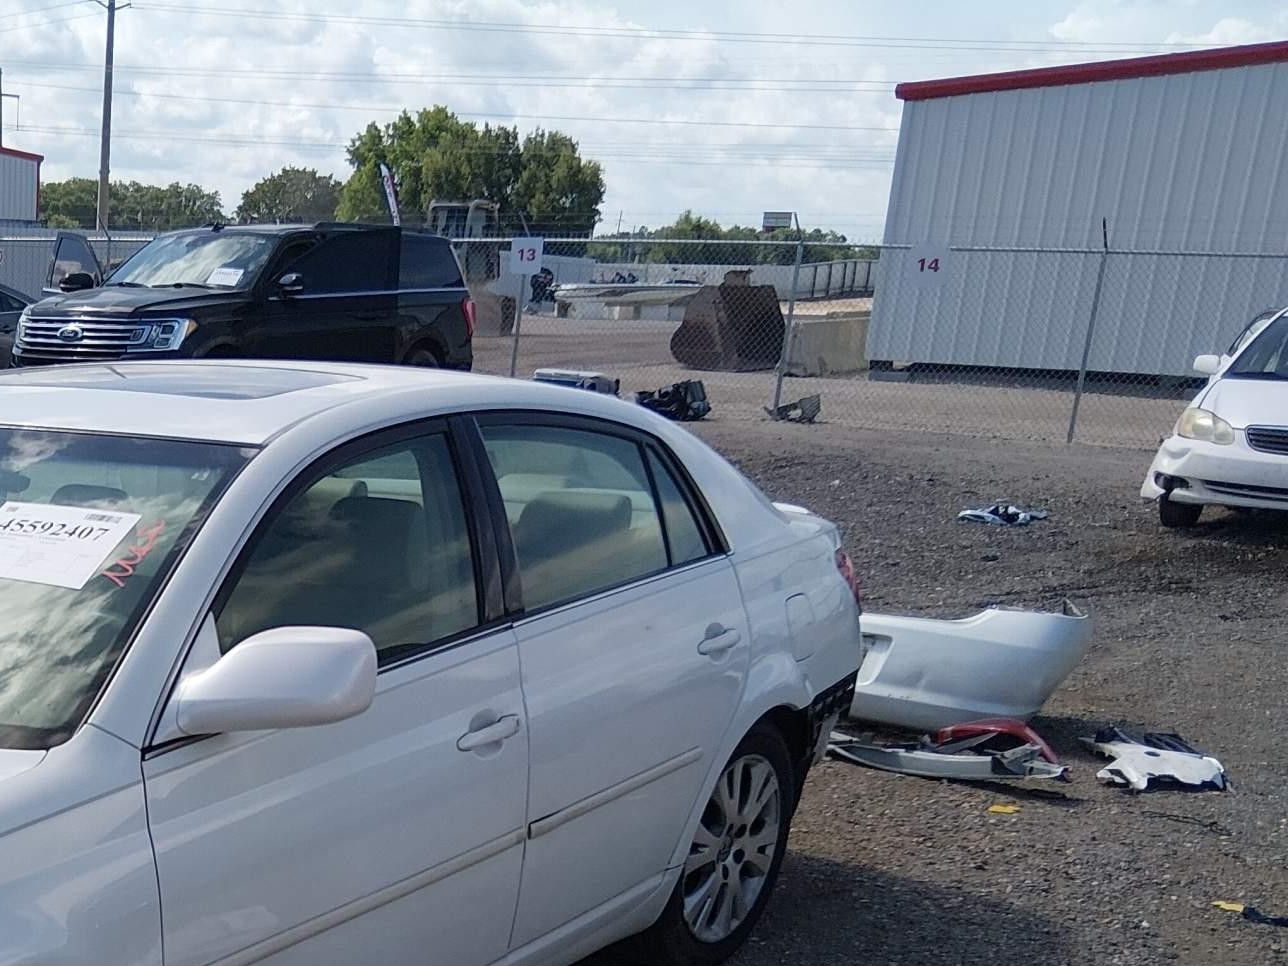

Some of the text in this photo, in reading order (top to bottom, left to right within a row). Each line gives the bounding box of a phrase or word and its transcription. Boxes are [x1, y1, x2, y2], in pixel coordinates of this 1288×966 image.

[518, 248, 536, 262] 13
[918, 258, 940, 272] 14
[0, 518, 110, 541] 45592407
